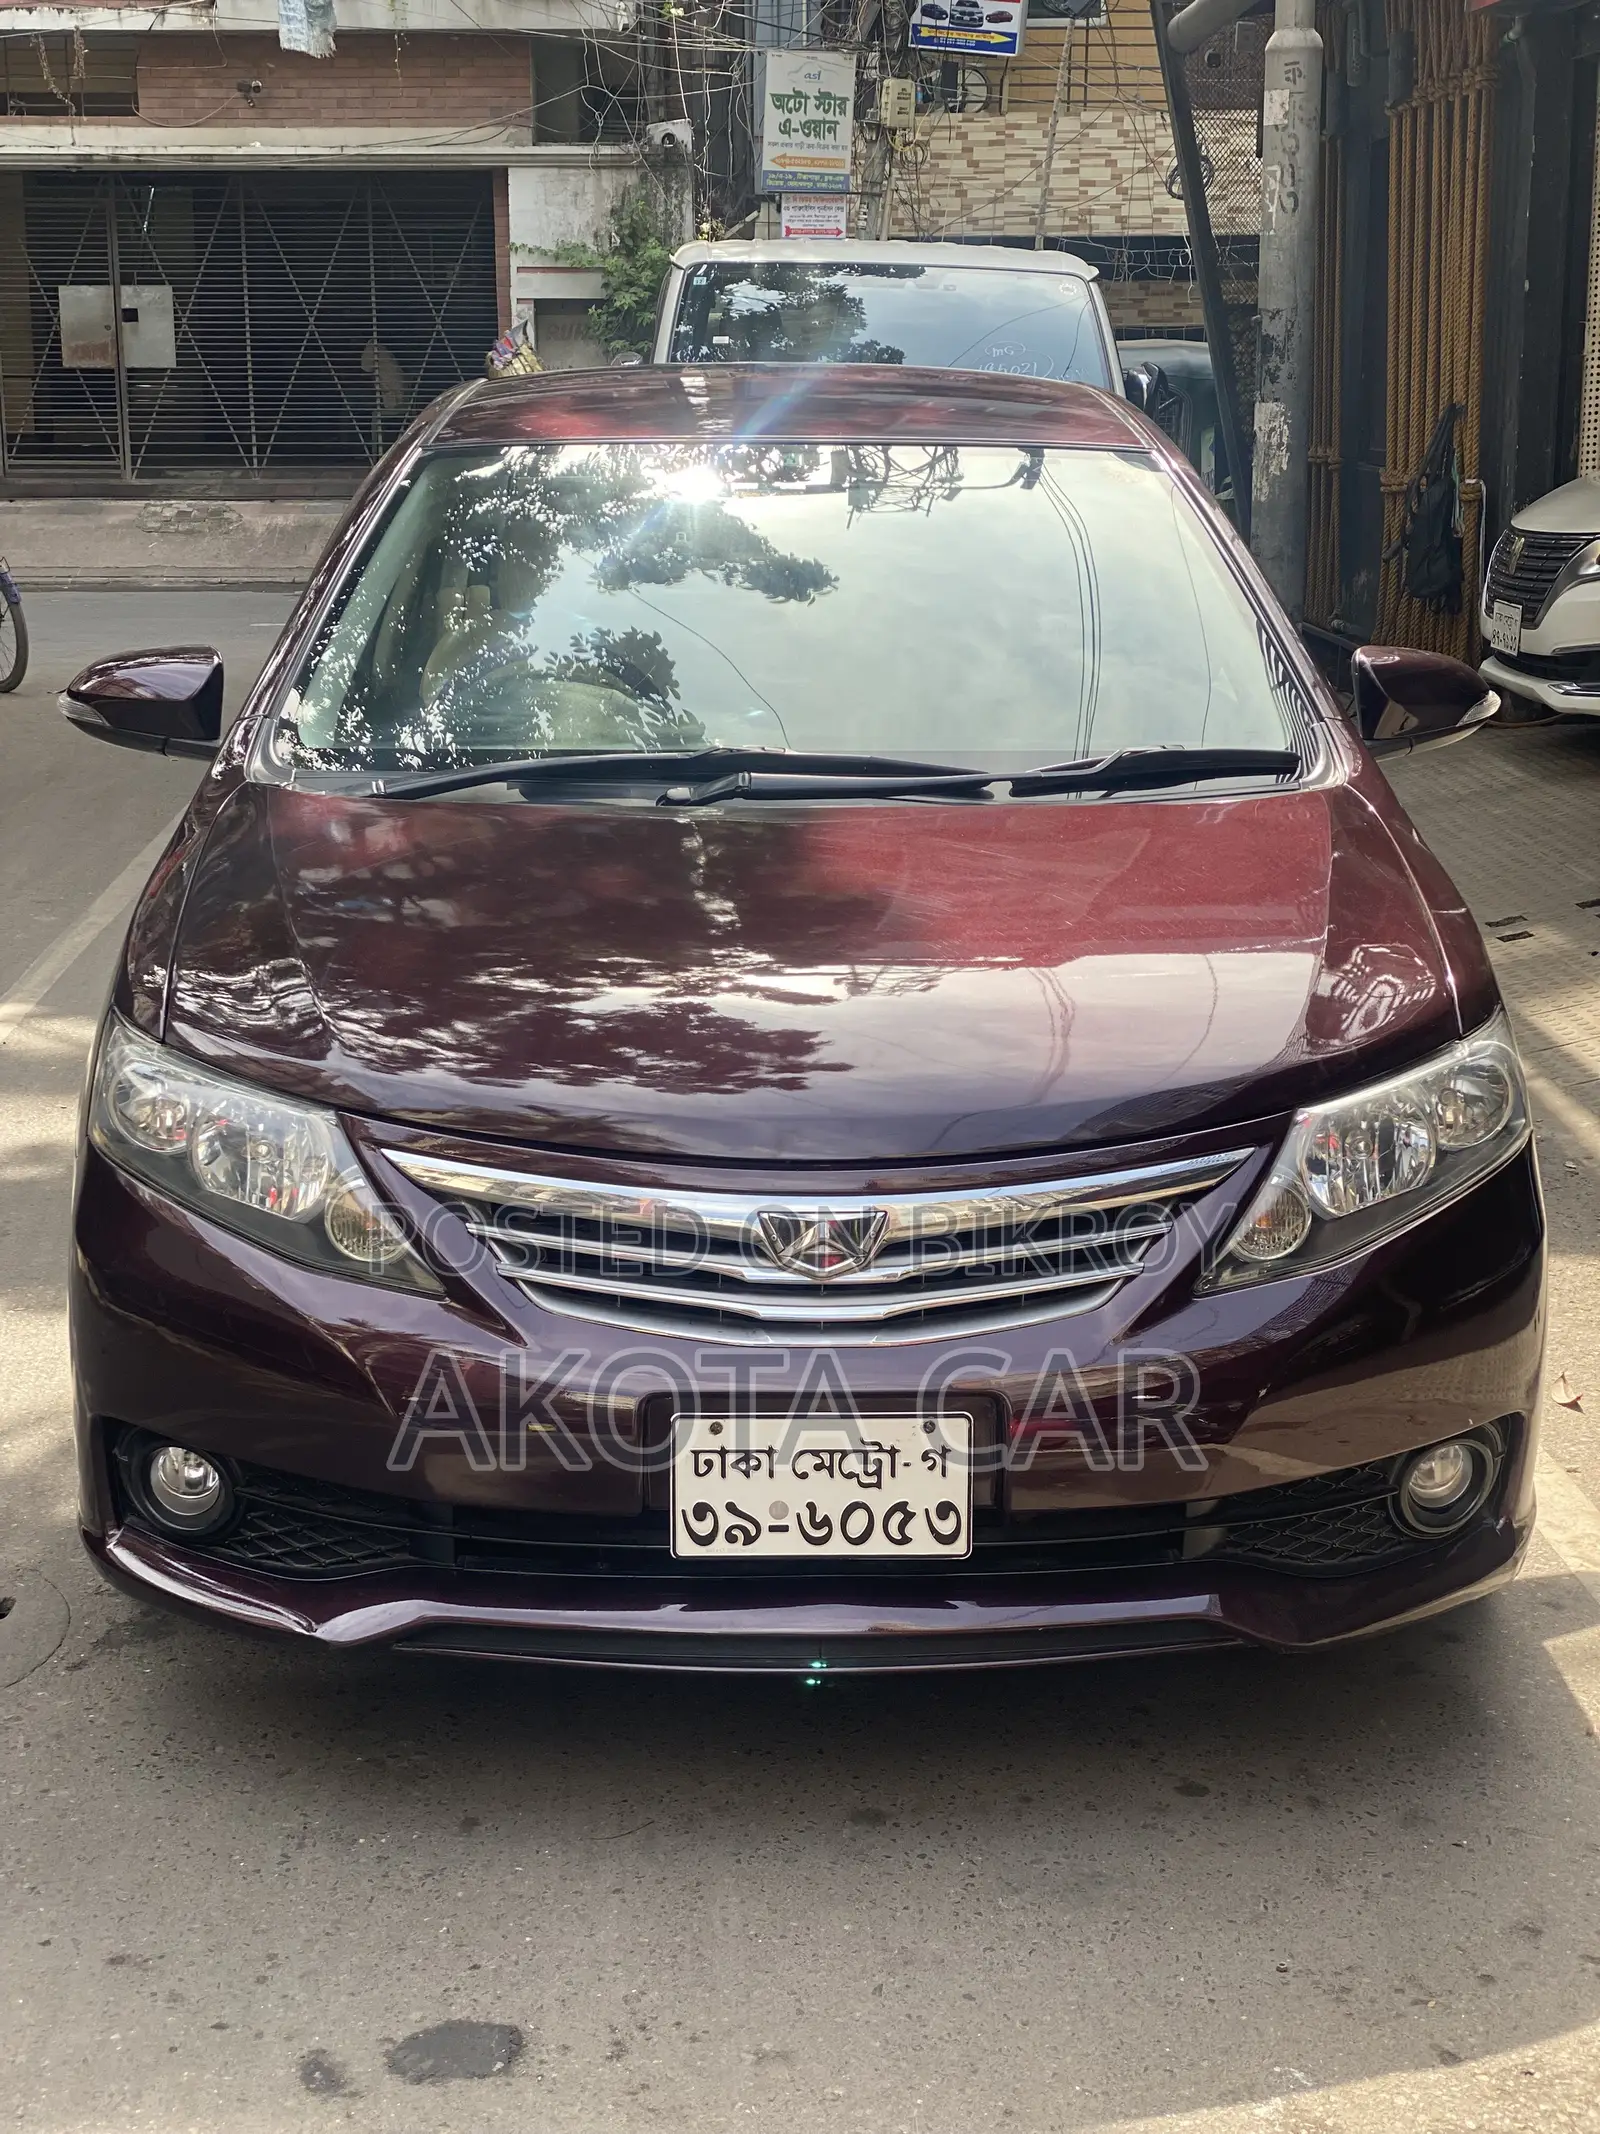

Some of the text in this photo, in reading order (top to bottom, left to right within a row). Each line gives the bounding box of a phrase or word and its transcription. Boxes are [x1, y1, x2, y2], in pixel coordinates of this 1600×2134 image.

[769, 87, 850, 117] অটো স্টার
[778, 117, 840, 142] এ-ওয়ান
[690, 1445, 779, 1479] ঢাকা
[681, 1500, 962, 1547] ৩৯-৬০৫৩
